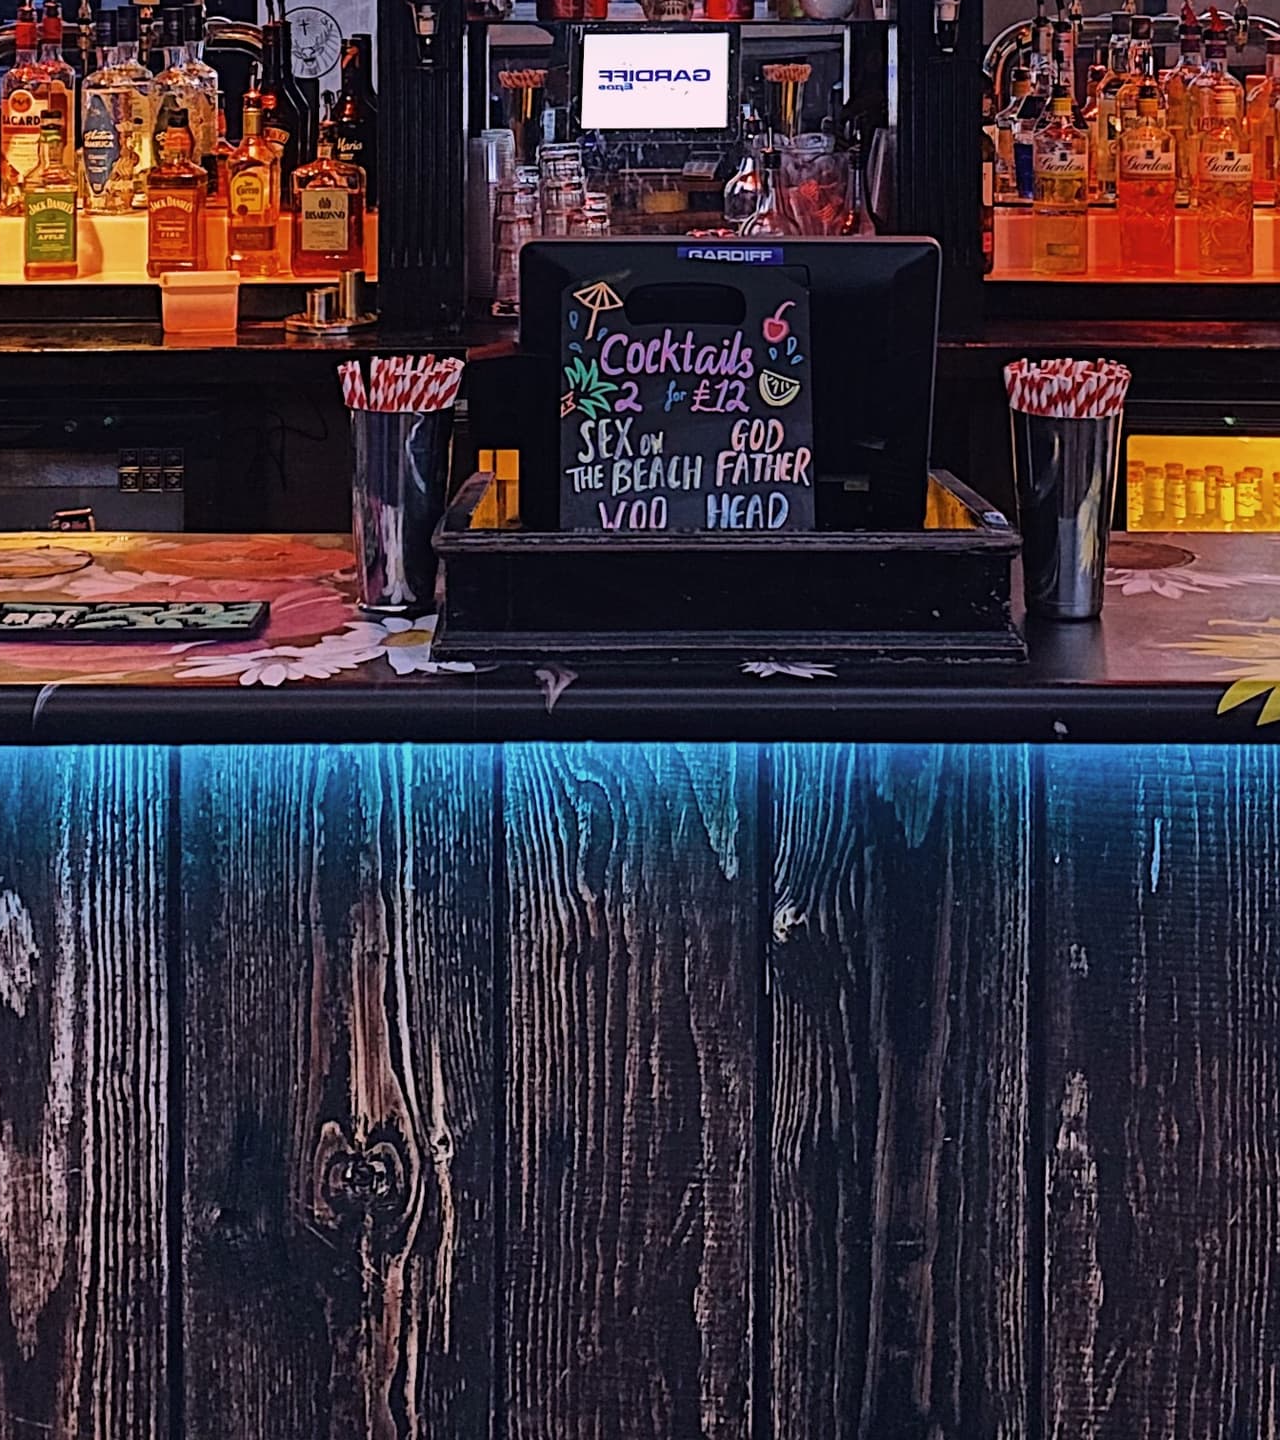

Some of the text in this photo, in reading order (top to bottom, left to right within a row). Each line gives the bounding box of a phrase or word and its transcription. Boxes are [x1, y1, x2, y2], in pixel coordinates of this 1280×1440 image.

[336, 137, 363, 152] Maria
[1039, 155, 1086, 172] Gordon's
[1123, 155, 1173, 172] Gordon's
[1205, 155, 1252, 173] Gordon's
[28, 197, 74, 216] JACK DANIEL'S
[149, 200, 166, 213] JACK
[304, 210, 346, 221] DISARONNO
[687, 250, 773, 262] GARDIFF
[600, 328, 754, 379] Cocktails
[614, 379, 750, 412] 2 for £12
[577, 417, 634, 464] SEX
[731, 418, 784, 453] GOD
[566, 455, 703, 497] THE BEACH
[715, 446, 811, 487] FATHER
[706, 492, 790, 529] HEAD
